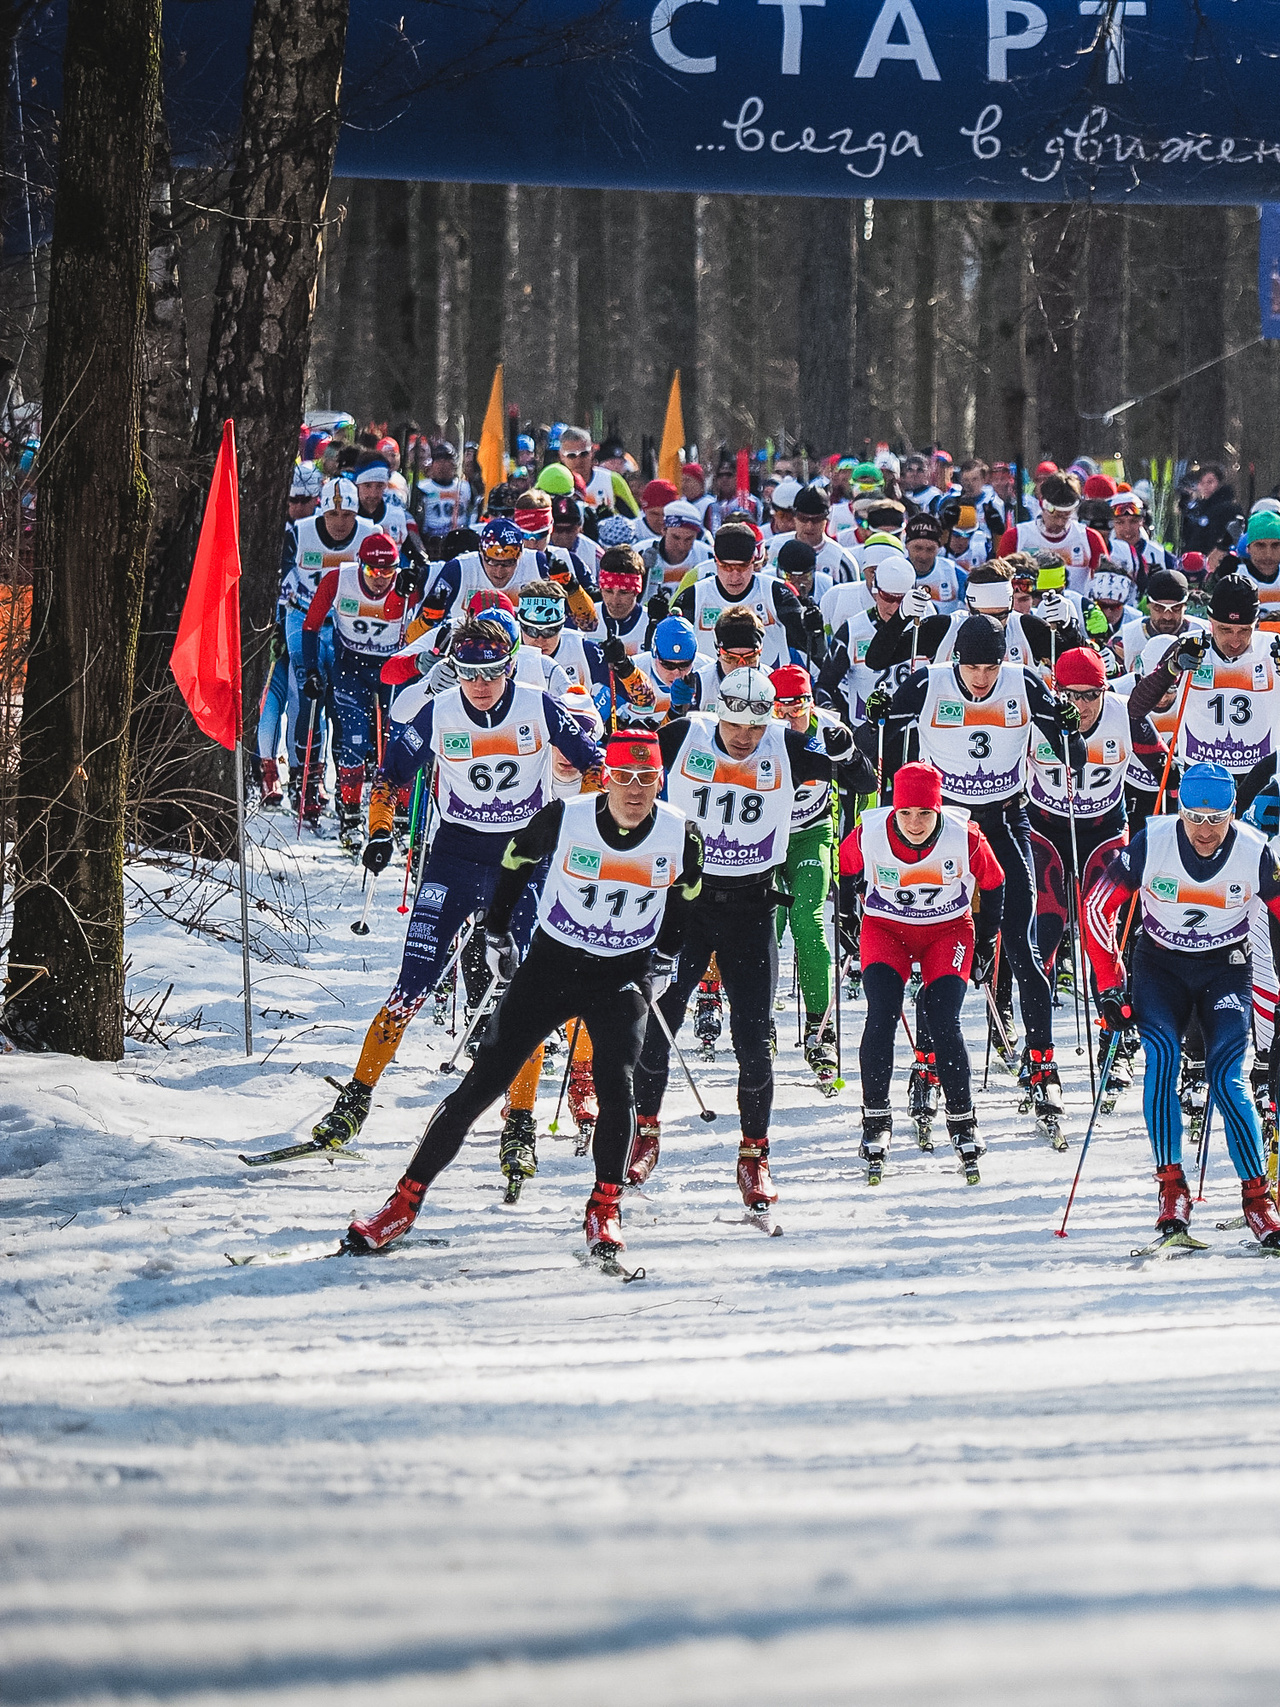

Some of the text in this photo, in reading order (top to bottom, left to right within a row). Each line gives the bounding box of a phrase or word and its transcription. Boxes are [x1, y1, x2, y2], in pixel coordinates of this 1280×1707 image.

[650, 0, 1147, 84] СТАРТ
[353, 619, 389, 637] 97
[1207, 693, 1253, 727] 13
[967, 730, 993, 760] 3
[1197, 744, 1261, 759] МАРАФОН
[468, 760, 521, 793] 62
[945, 775, 1012, 790] МАРАФОН
[1044, 766, 1114, 791] 112
[692, 785, 765, 826] 118
[705, 846, 759, 859] РАФОН
[577, 883, 658, 919] 111
[1181, 908, 1210, 928] 2
[1213, 1002, 1245, 1013] adidas
